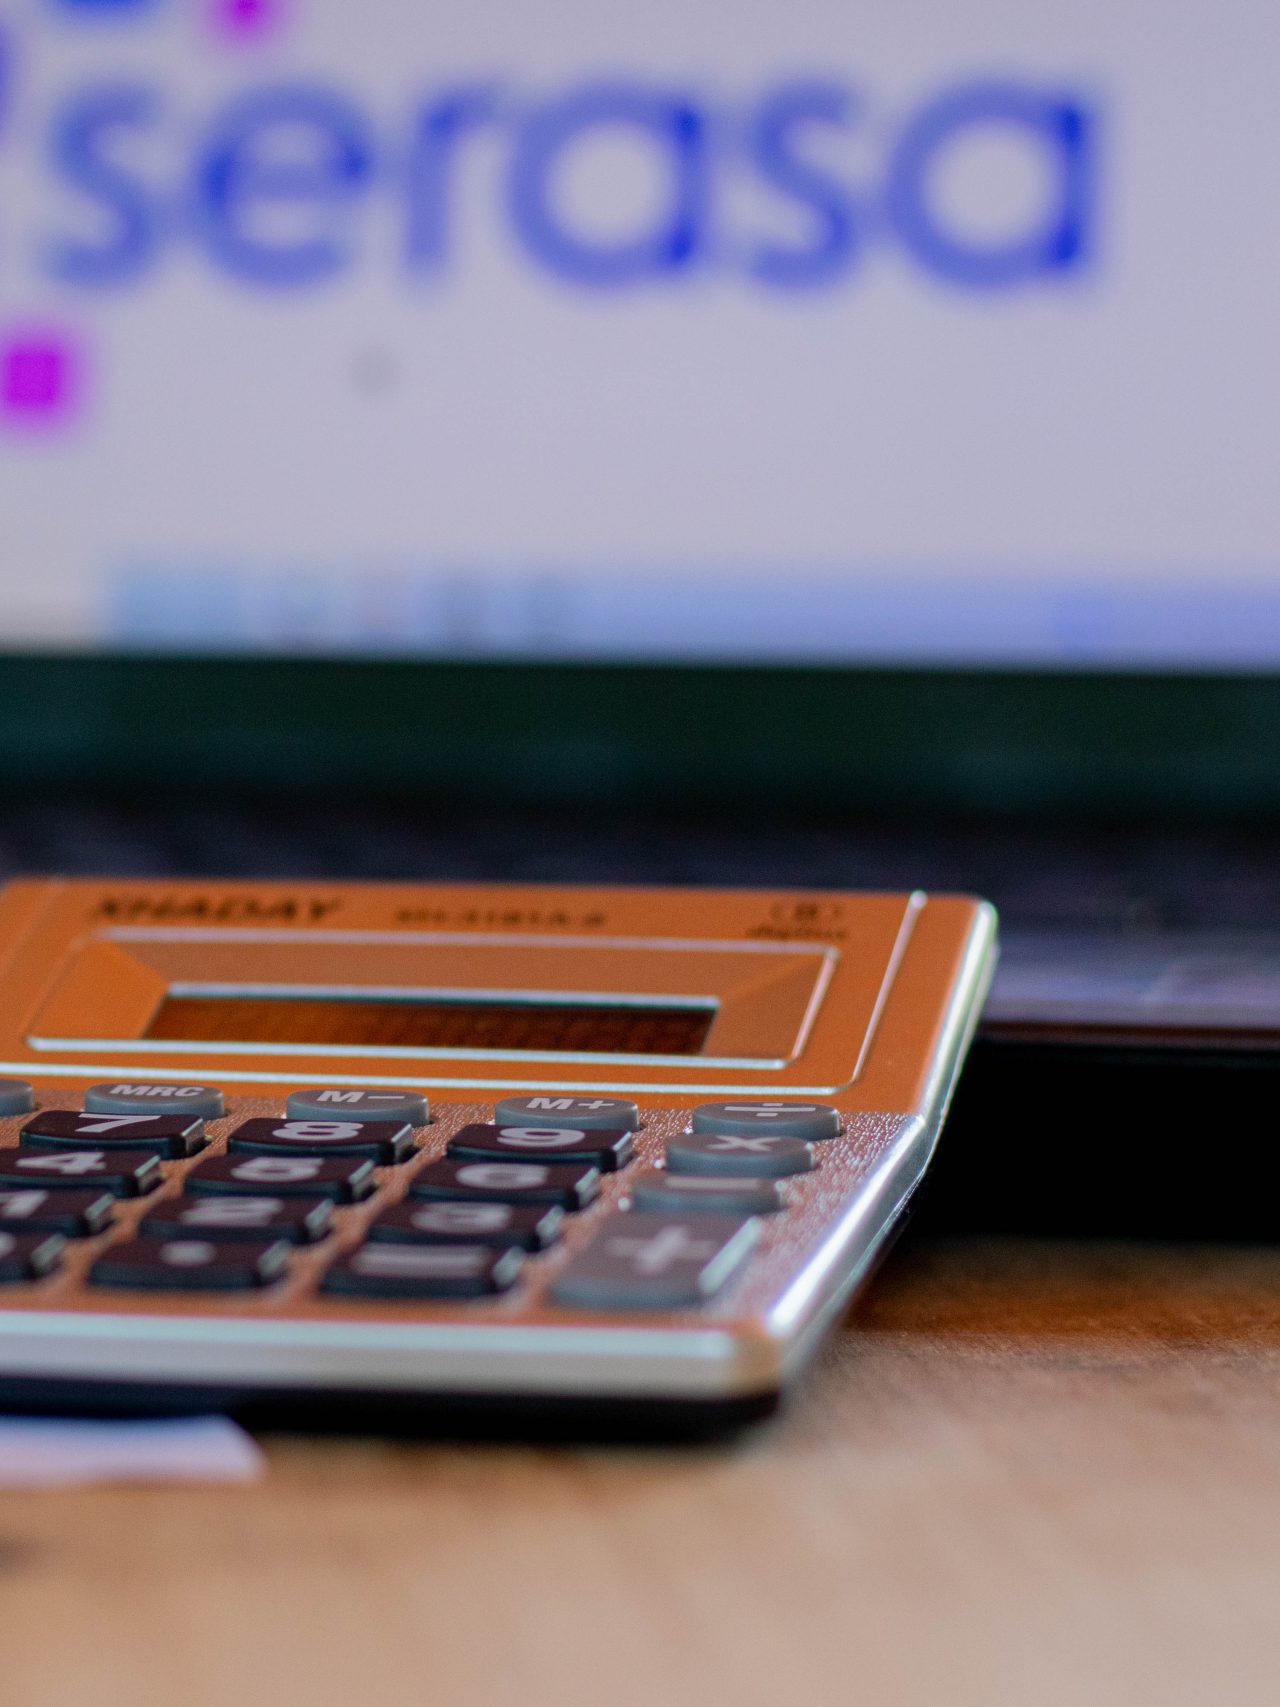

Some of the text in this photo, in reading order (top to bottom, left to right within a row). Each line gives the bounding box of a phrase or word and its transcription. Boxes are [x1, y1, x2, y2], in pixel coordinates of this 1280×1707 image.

[35, 78, 1096, 293] serasa
[109, 1083, 208, 1098] MRC
[525, 1096, 615, 1111] M+
[73, 1112, 162, 1133] 7
[271, 1120, 365, 1142] 8
[495, 1126, 587, 1148] 9
[14, 1150, 107, 1175] 4
[229, 1155, 325, 1183] 5
[455, 1162, 549, 1189] 6
[178, 1197, 284, 1227] 2
